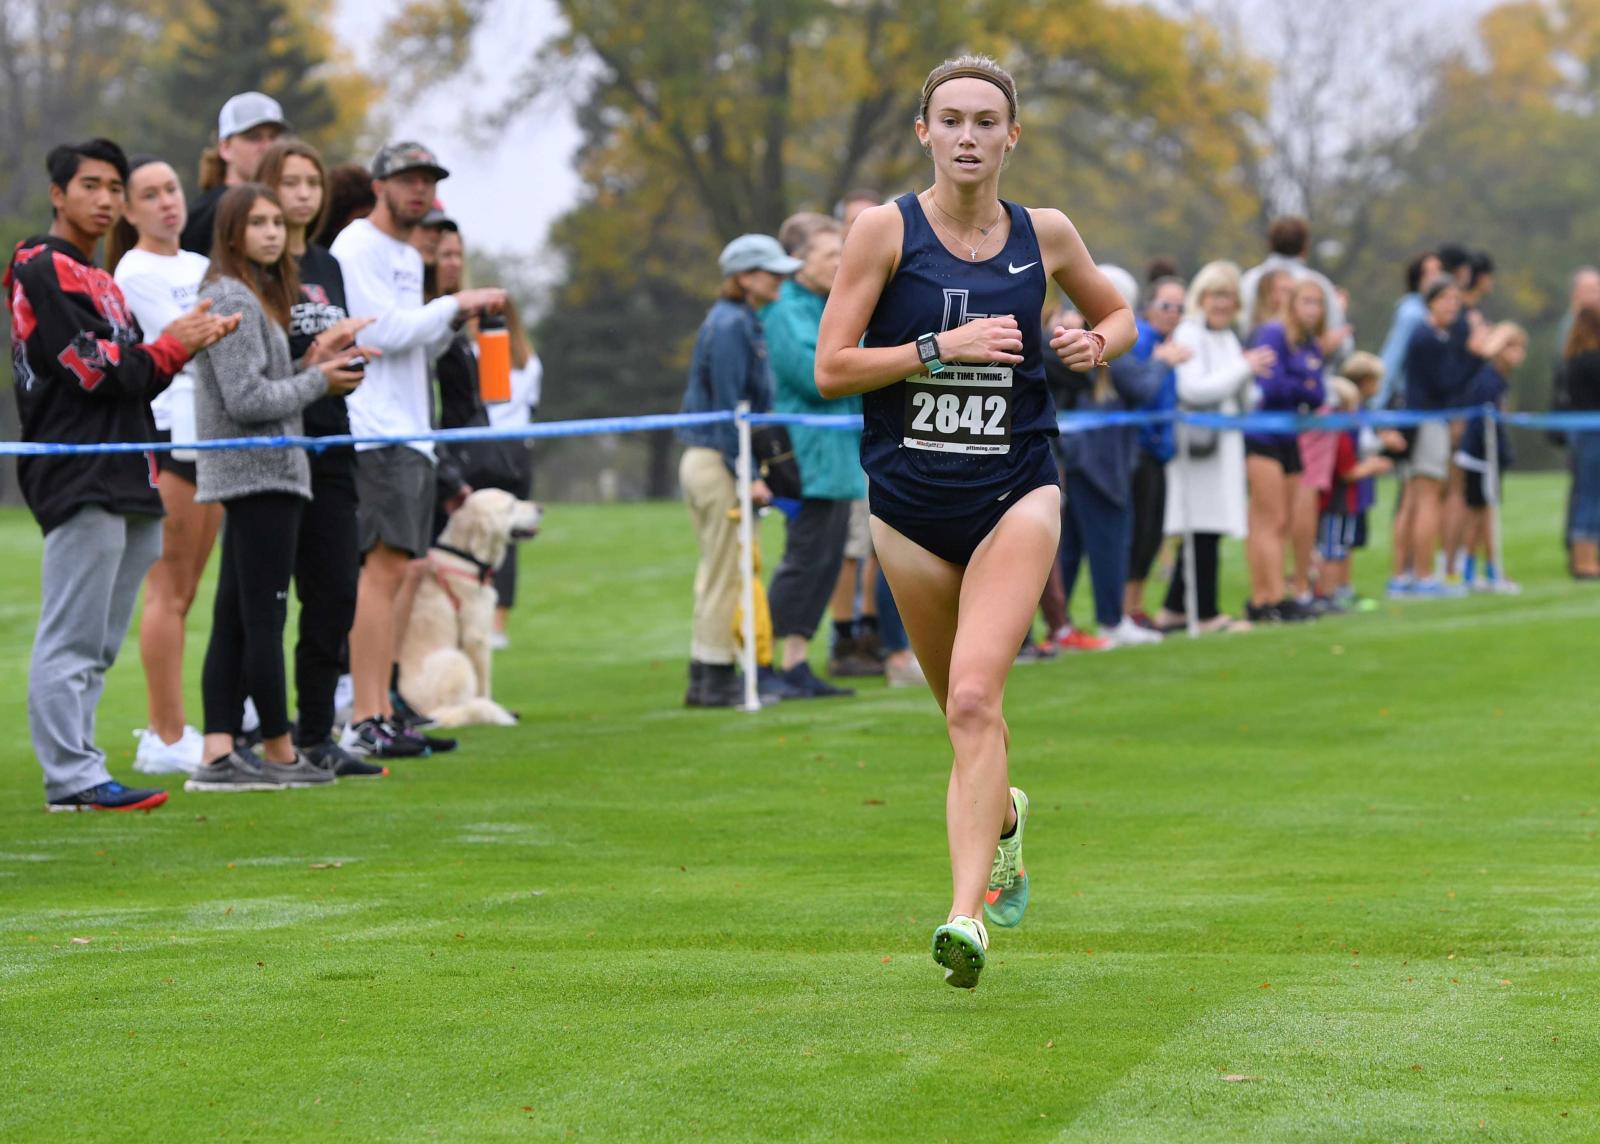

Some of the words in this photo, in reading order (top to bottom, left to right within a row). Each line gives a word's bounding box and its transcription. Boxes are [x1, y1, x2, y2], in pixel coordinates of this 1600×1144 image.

[931, 371, 955, 380] PRIME
[956, 372, 975, 381] TIME
[976, 372, 1003, 382] TIMING
[911, 391, 1007, 436] 2842
